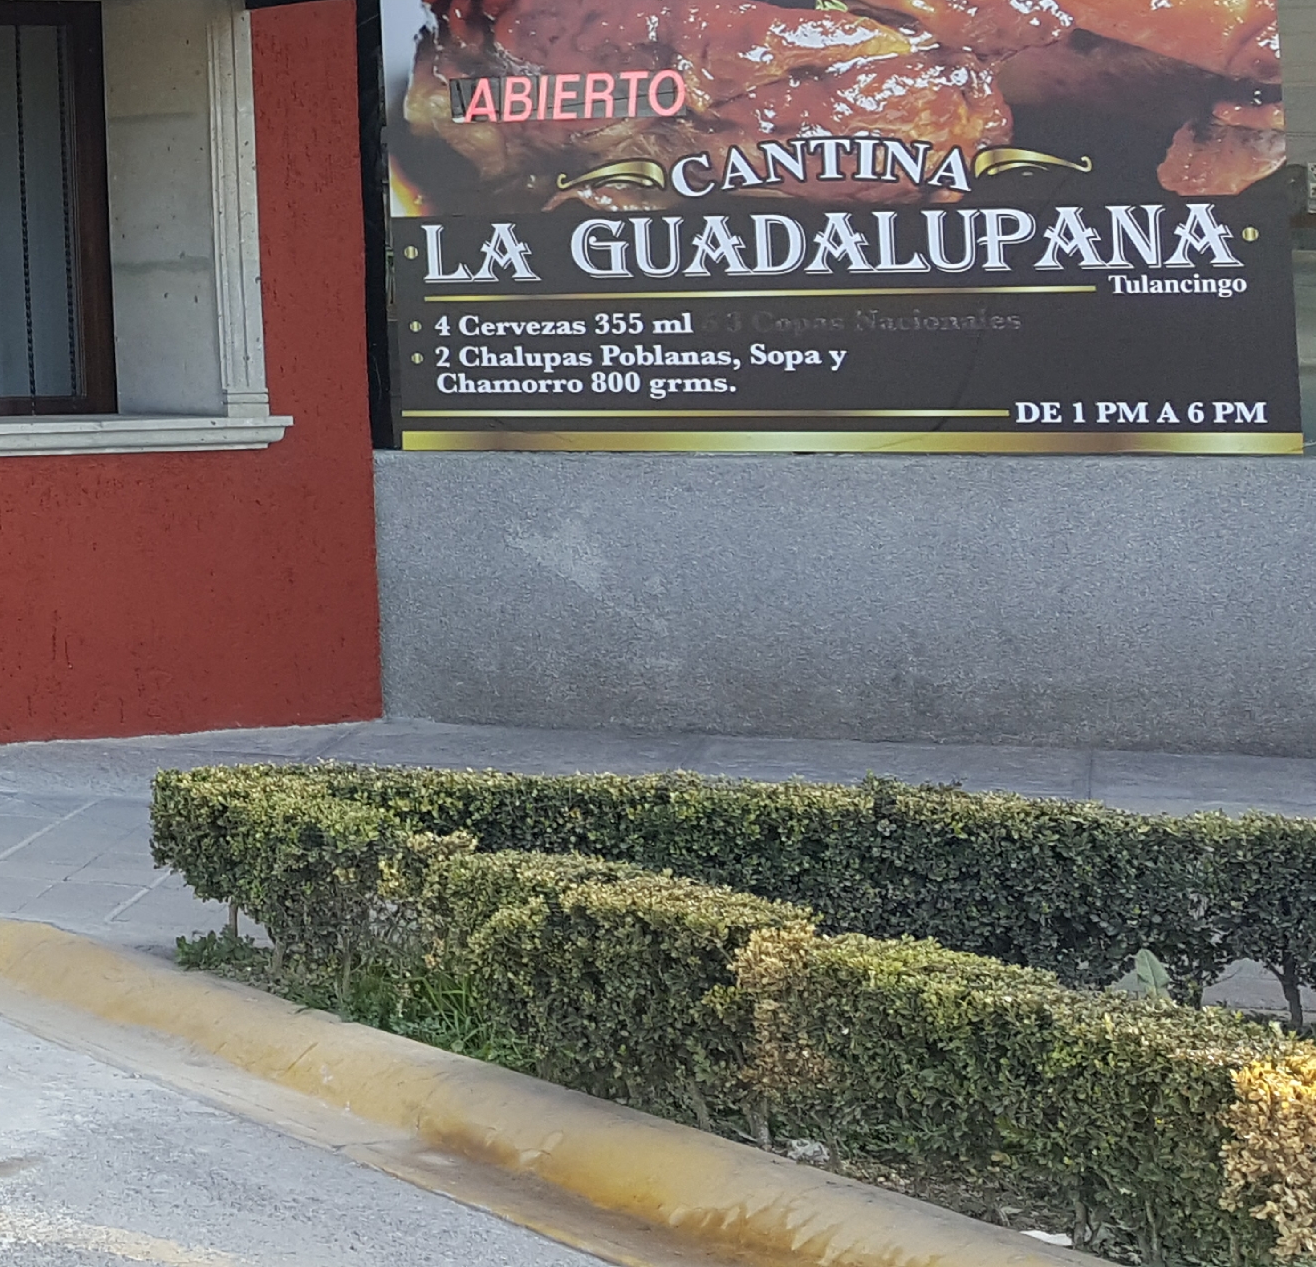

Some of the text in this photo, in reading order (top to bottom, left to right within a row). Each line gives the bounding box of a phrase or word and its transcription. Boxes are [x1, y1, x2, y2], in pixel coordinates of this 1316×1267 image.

[464, 69, 686, 123] ABIERTO
[671, 138, 971, 197] CANTINA
[421, 203, 1245, 283] LA GUADALUPANA
[1108, 275, 1248, 298] Tulancingo
[435, 319, 450, 336] 4
[458, 315, 586, 337] Cervezas
[594, 313, 644, 335] 355
[652, 312, 694, 334] ml
[435, 343, 848, 373] 2 Chalupas Poblanas, Sopa y
[436, 372, 737, 399] Chamorro 800 grms.
[1015, 401, 1268, 423] DE 1 PM A 6 PM
